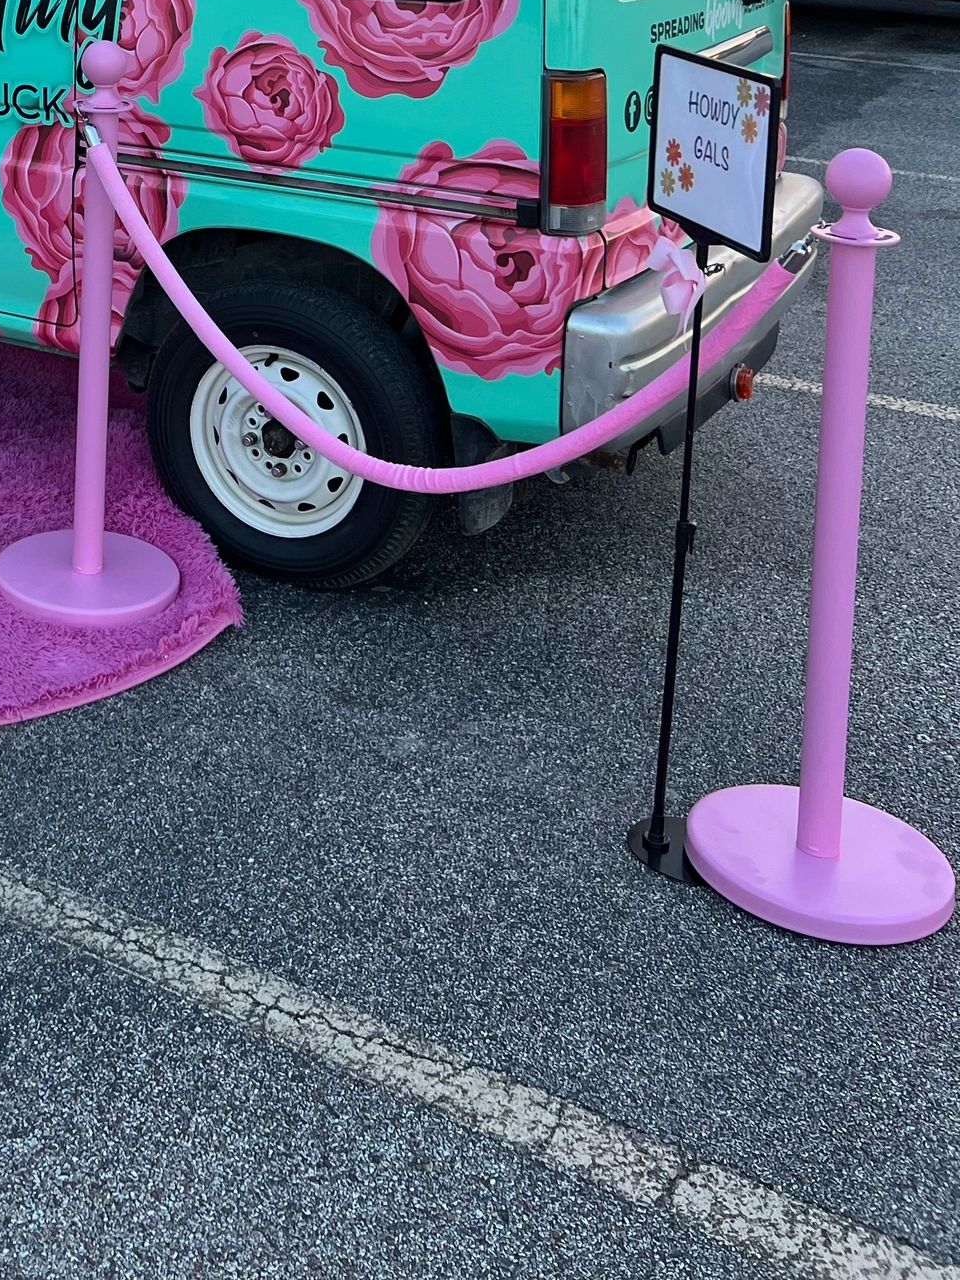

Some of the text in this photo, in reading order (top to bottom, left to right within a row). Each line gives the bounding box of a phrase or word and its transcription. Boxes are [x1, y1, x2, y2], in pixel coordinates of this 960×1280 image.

[650, 11, 705, 43] SPREADING
[688, 90, 740, 130] HOWDY
[694, 135, 730, 172] GALS
